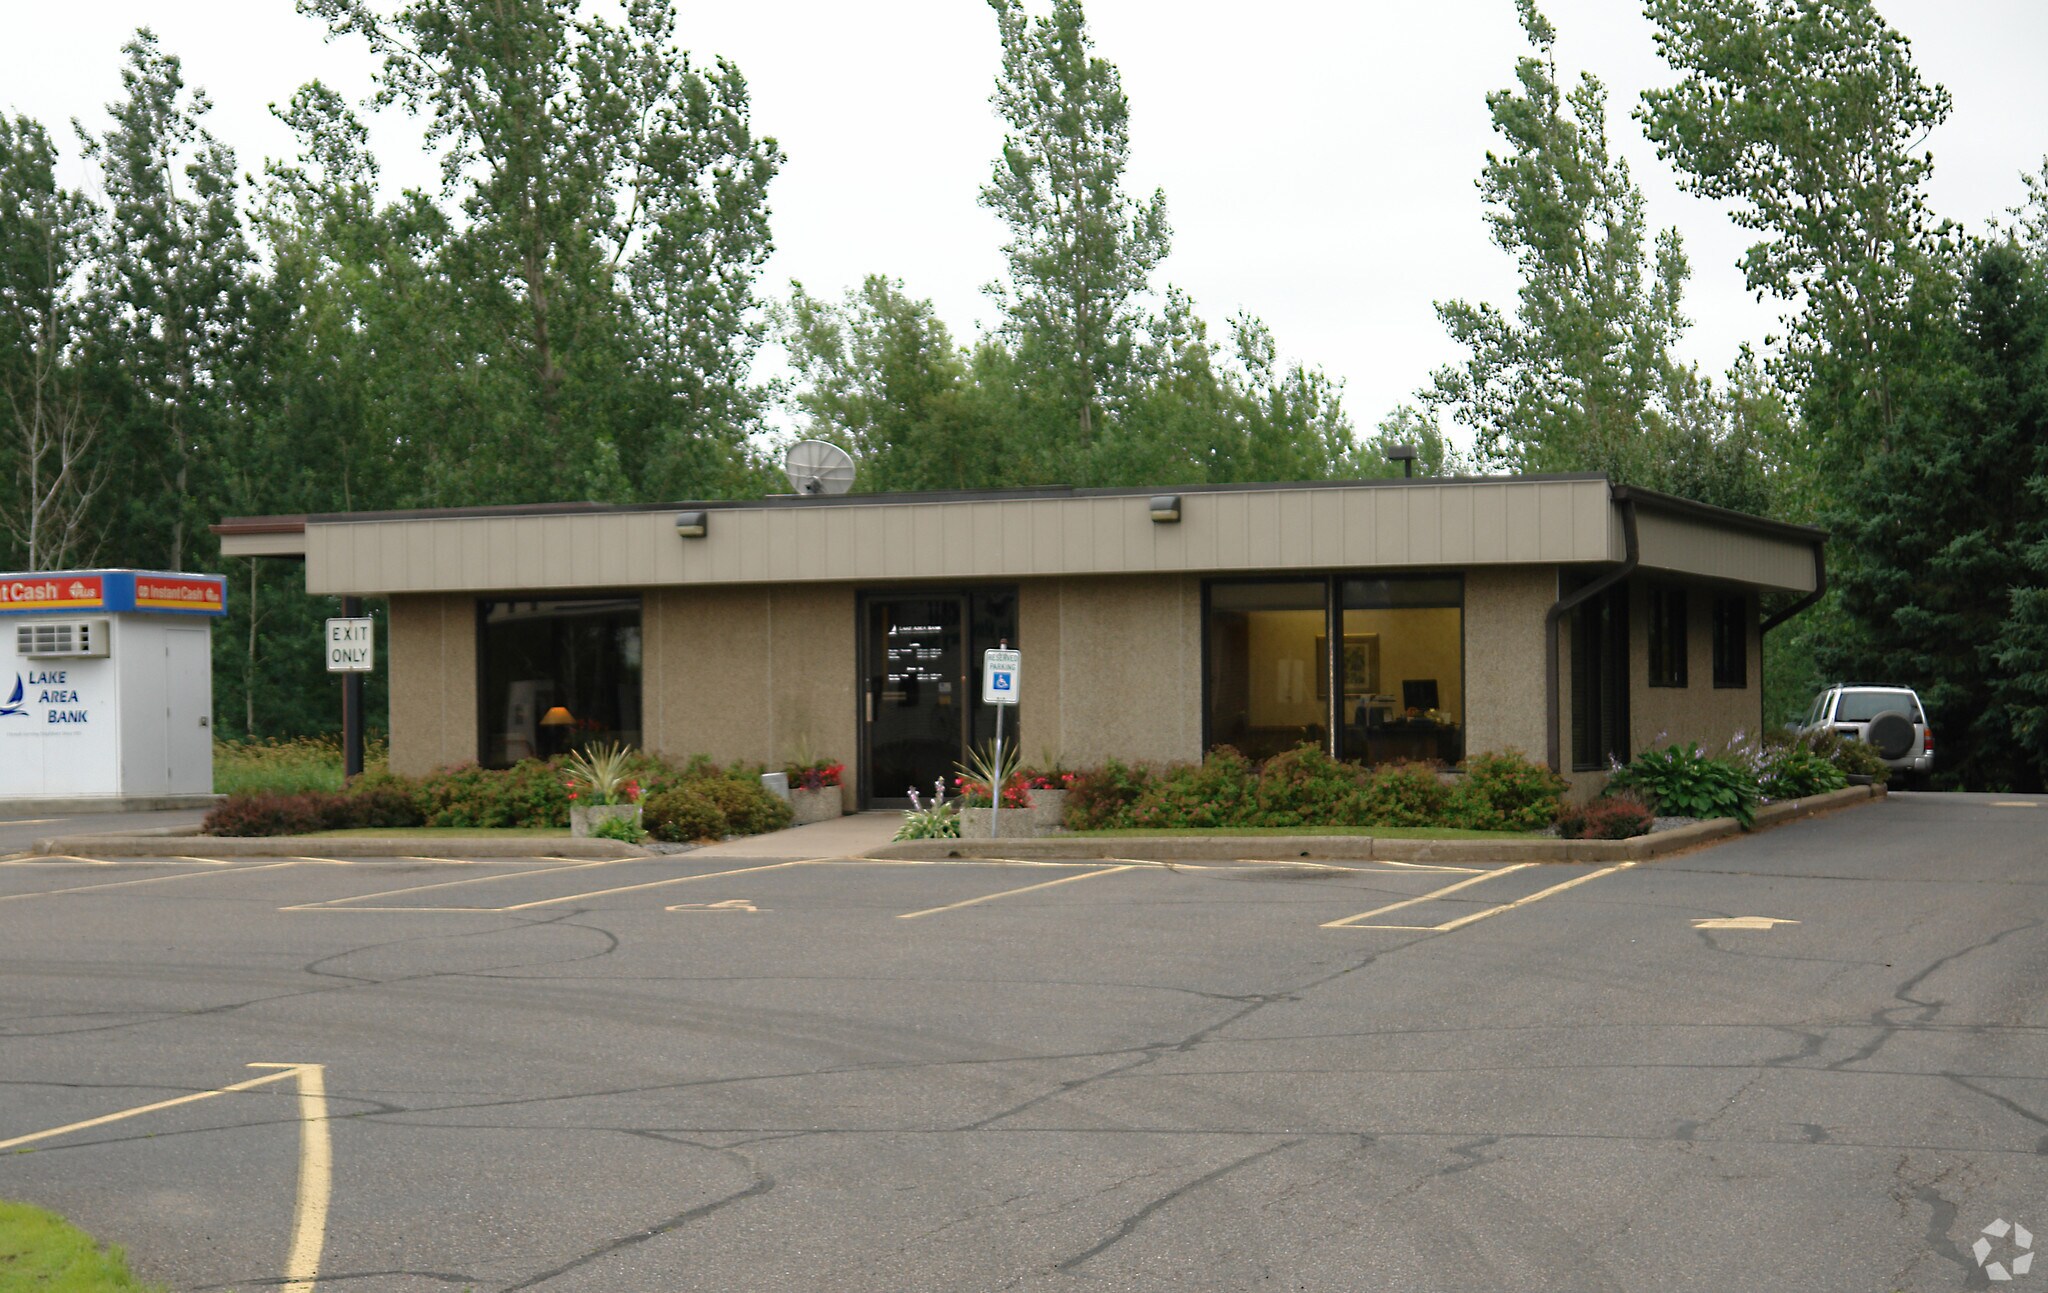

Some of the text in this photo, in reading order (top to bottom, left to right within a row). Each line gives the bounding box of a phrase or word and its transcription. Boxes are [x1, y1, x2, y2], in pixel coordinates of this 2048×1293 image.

[10, 582, 57, 601] Cash
[150, 585, 181, 600] Instant
[181, 586, 204, 601] Cash
[332, 626, 368, 641] EXIT
[332, 648, 368, 663] ONLY
[29, 671, 66, 684] LAKE
[38, 689, 79, 703] AREA
[47, 709, 88, 723] BANK
